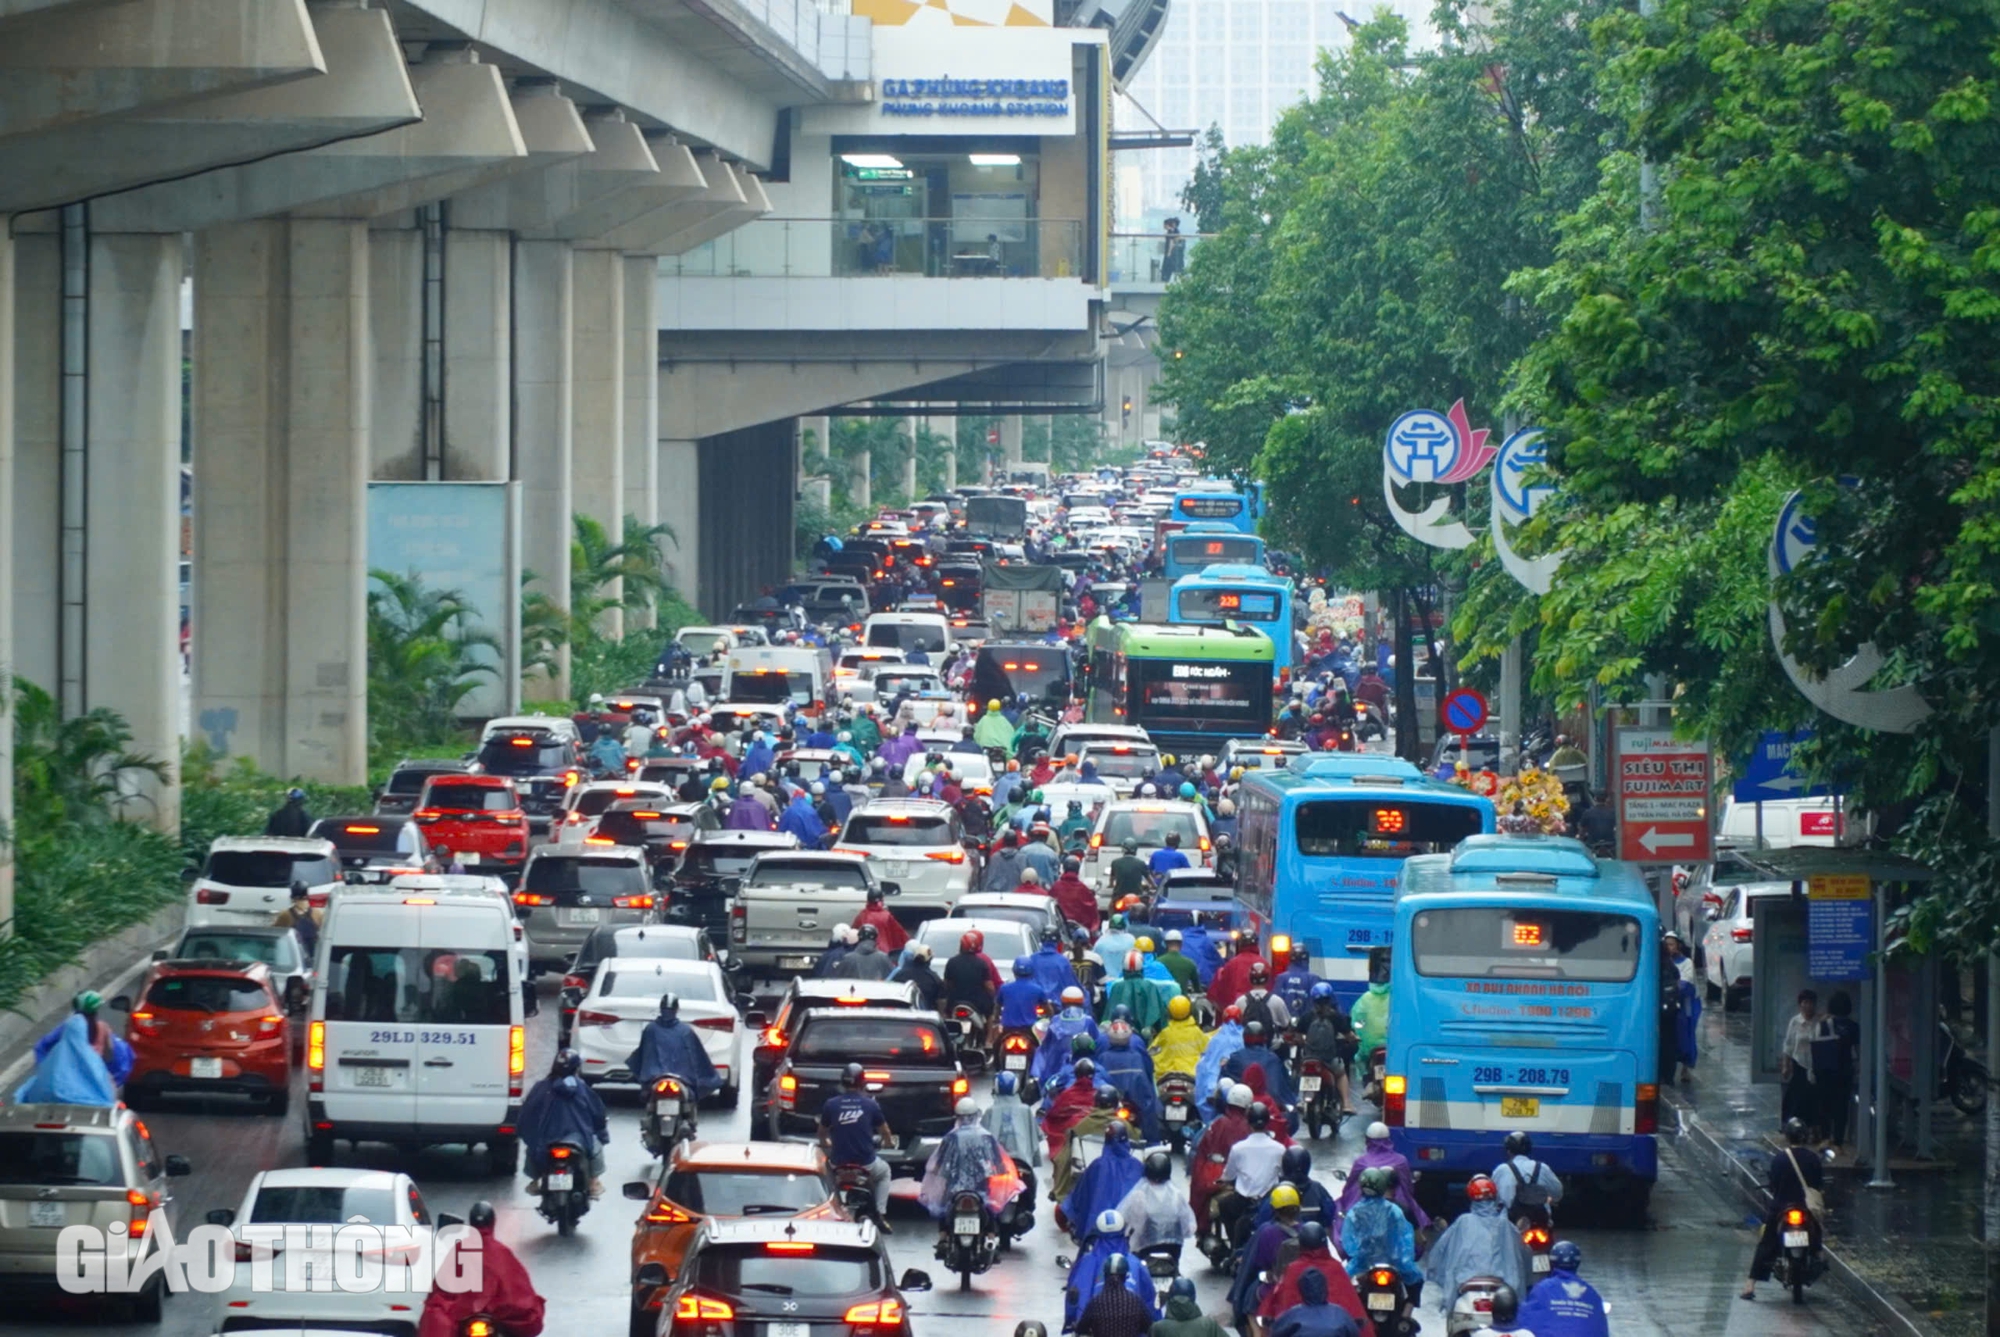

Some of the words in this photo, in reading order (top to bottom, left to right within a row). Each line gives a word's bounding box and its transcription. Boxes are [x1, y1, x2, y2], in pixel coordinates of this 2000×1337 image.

[883, 79, 909, 97] GA
[986, 79, 1068, 99] KHOANG
[883, 103, 934, 116] PHUNG
[939, 103, 1002, 116] KHOANG
[1007, 103, 1068, 116] STATION
[1625, 758, 1665, 774] SIÊU
[1671, 761, 1704, 777] THỊ
[1625, 781, 1704, 793] FUJIMART
[1376, 810, 1403, 832] 39
[1348, 930, 1371, 943] 29B
[1514, 924, 1540, 945] 02
[371, 1031, 415, 1044] 29LD
[420, 1032, 477, 1045] 329.51
[1474, 1067, 1503, 1083] 29B
[1518, 1068, 1570, 1085] 208.79
